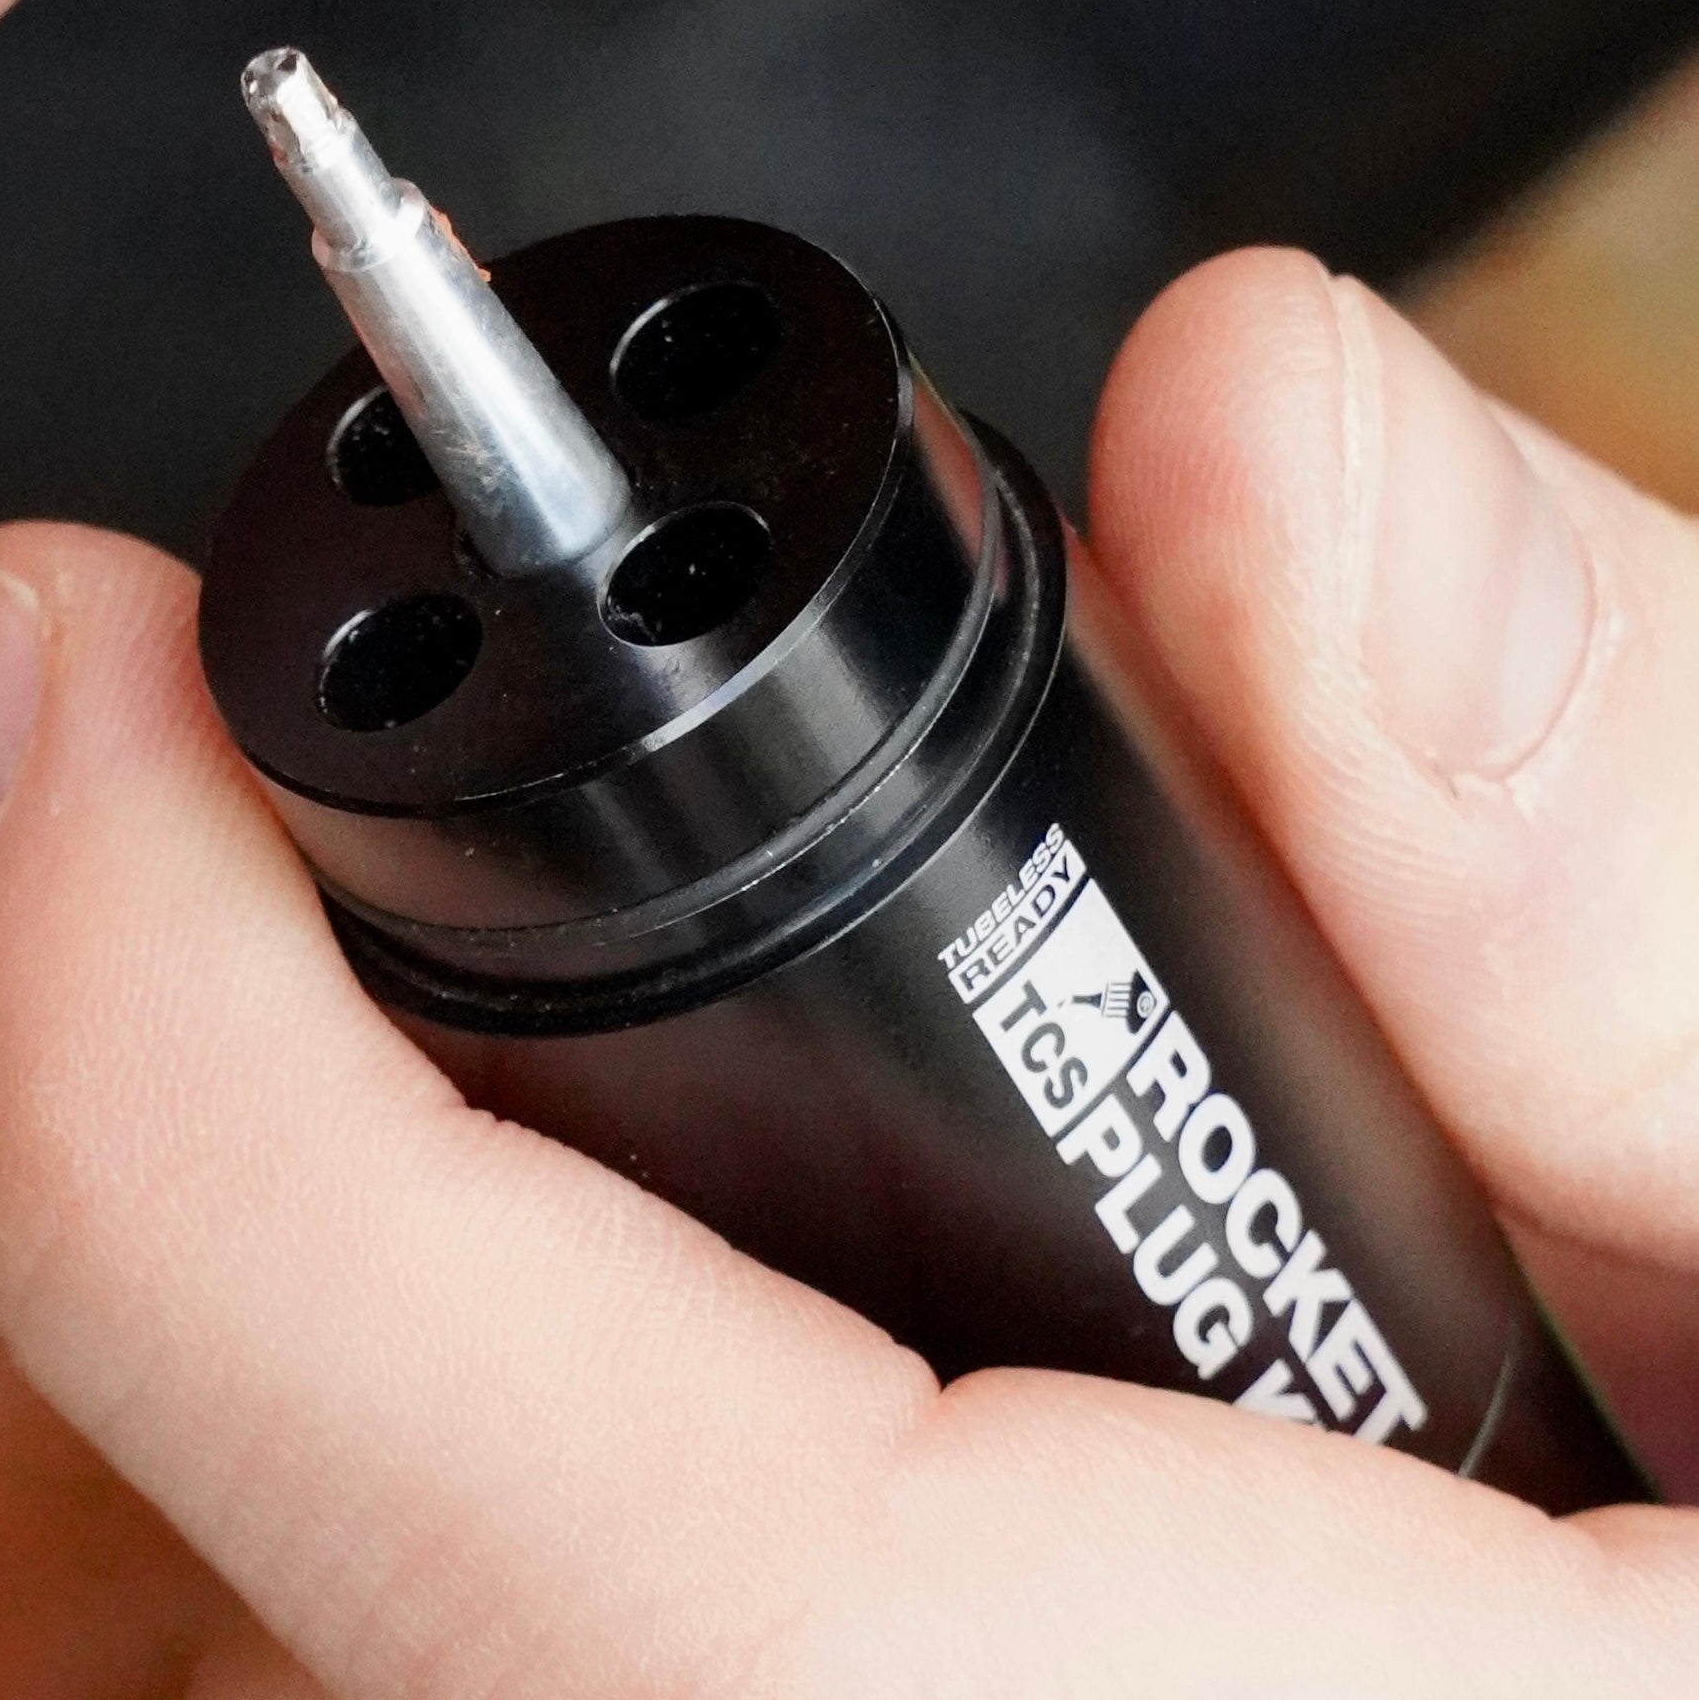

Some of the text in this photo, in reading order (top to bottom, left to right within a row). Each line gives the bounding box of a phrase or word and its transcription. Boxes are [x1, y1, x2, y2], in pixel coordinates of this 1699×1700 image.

[937, 822, 1066, 970] TUBELESS
[959, 852, 1076, 993] READY
[1000, 980, 1089, 1111] TCS
[1056, 1095, 1253, 1379] PLUG
[1126, 1010, 1428, 1446] ROCKET
